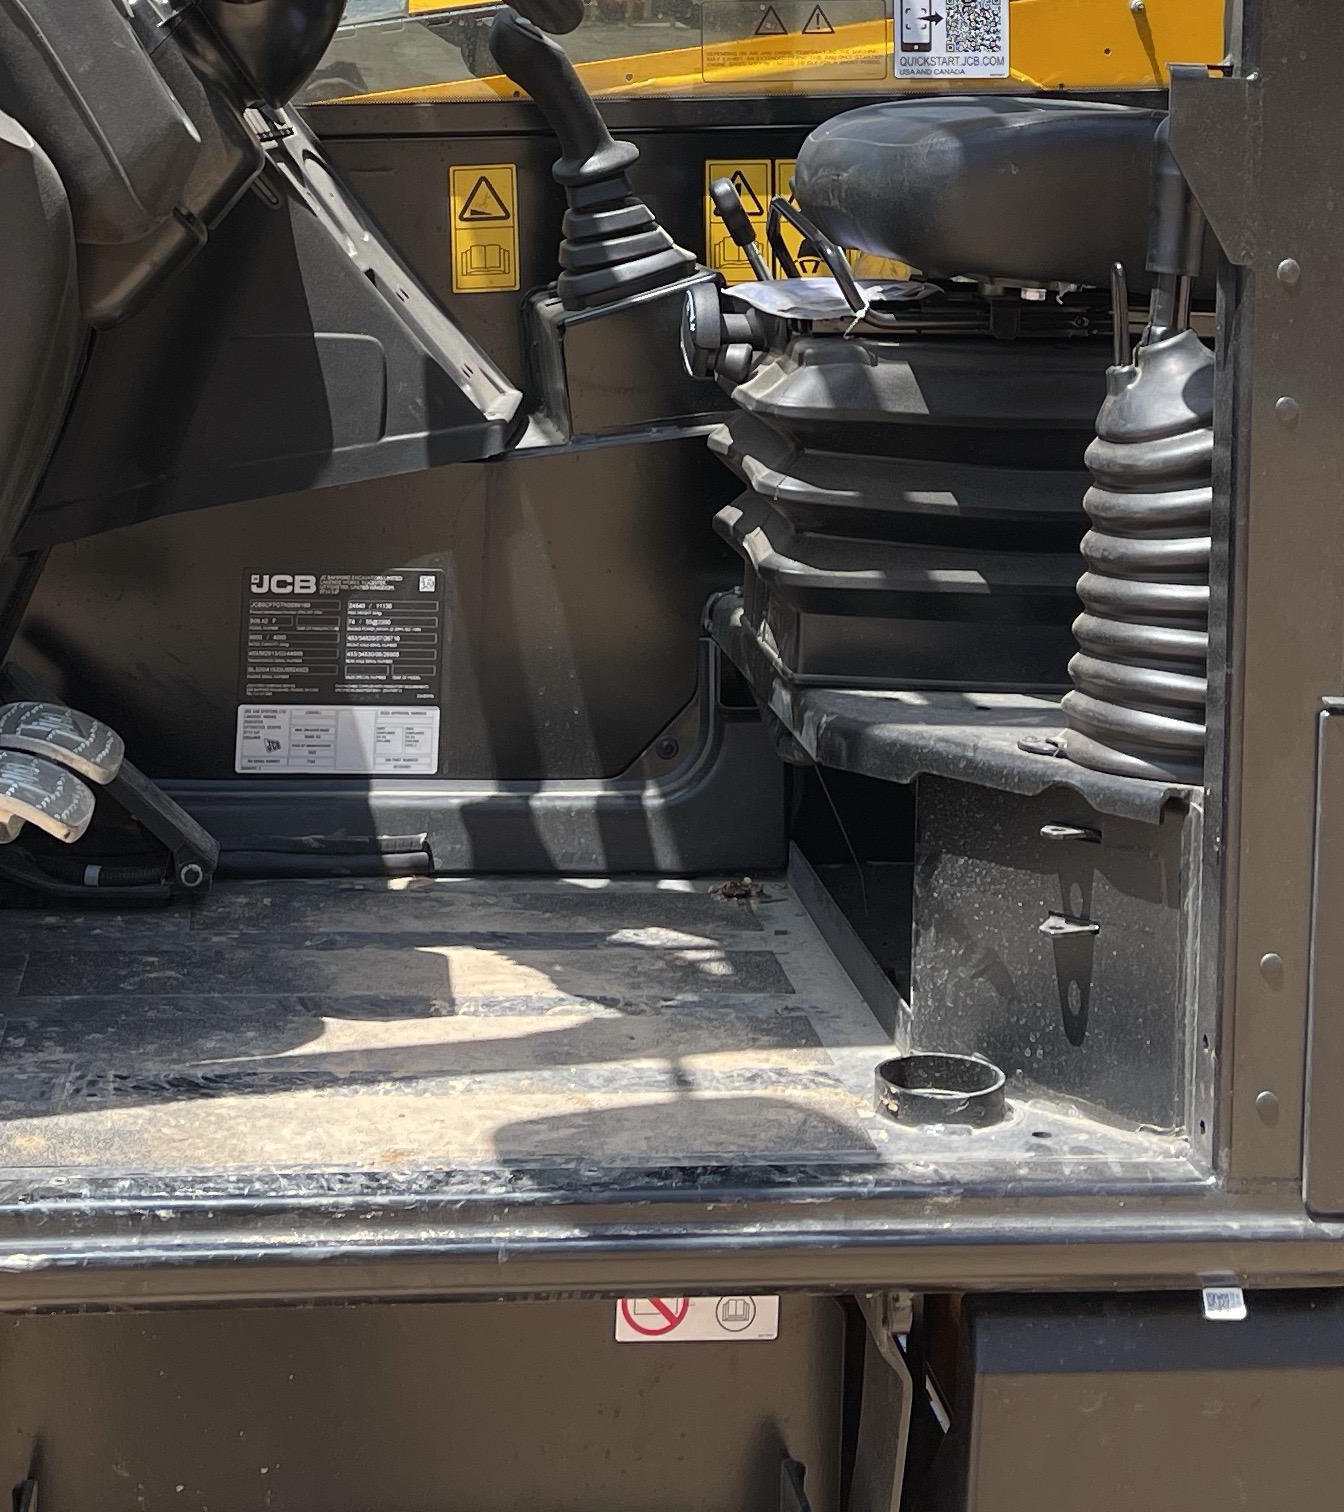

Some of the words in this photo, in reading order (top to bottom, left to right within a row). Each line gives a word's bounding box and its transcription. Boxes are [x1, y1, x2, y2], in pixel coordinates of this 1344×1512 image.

[899, 55, 1005, 68] QUICKSTART.JCB.COM
[899, 68, 915, 76] USA
[915, 68, 933, 76] AND
[933, 68, 966, 76] CANADA
[250, 574, 317, 594] JCB
